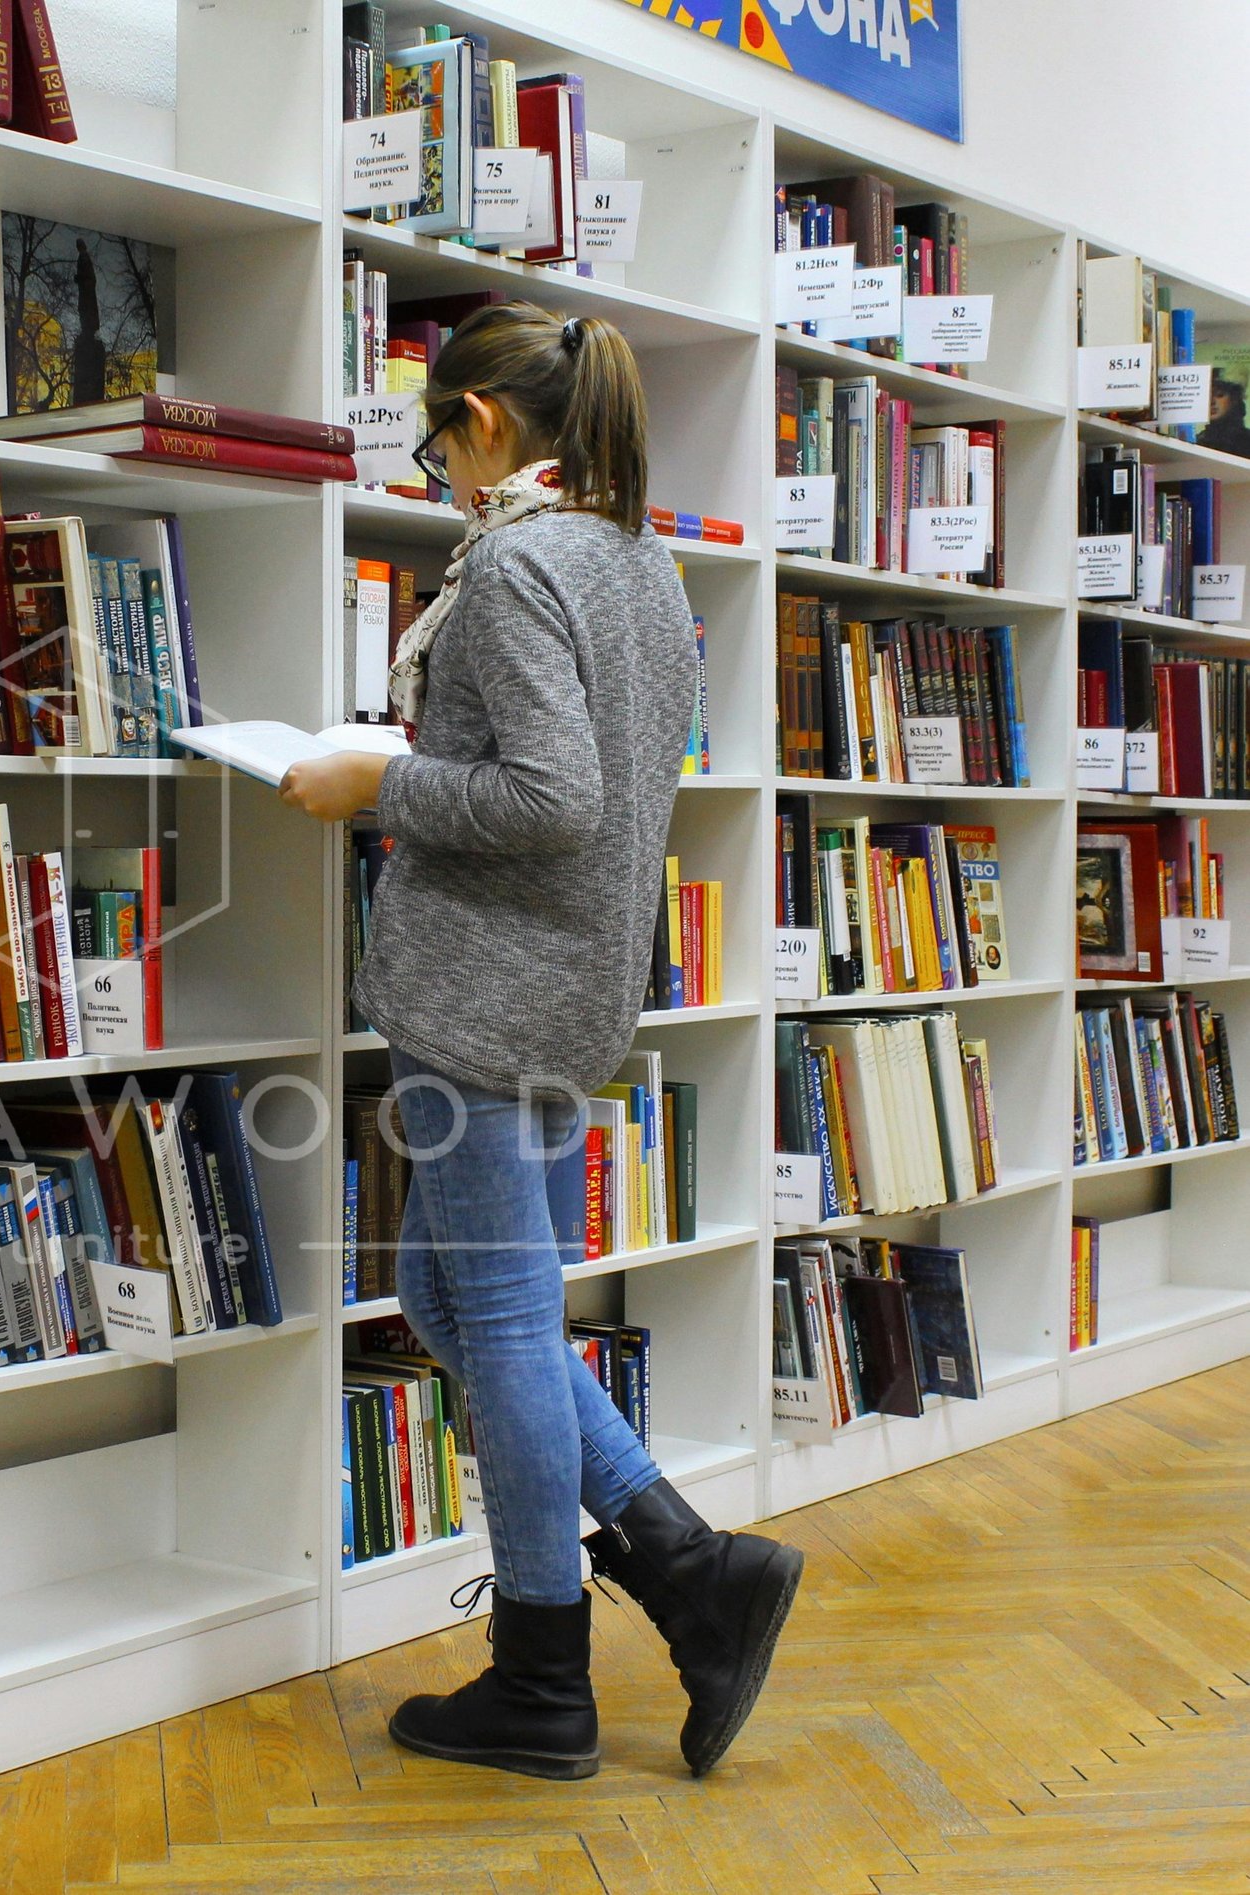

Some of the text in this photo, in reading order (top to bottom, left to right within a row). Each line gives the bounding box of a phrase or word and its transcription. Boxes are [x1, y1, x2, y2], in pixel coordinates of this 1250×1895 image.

[43, 73, 62, 90] 13
[48, 102, 69, 115] Т-Ц
[370, 132, 385, 147] 74
[486, 162, 503, 178] 75
[595, 195, 611, 210] 81
[576, 215, 627, 225] Языкознание
[586, 238, 612, 248] языке)
[795, 258, 838, 270] 81.2Нем
[798, 282, 835, 292] Немецкий
[952, 307, 966, 318] 82
[1109, 358, 1141, 370] 85.14
[161, 403, 217, 428] МОСКВА
[348, 408, 403, 427] 81.2Рус
[161, 435, 216, 458] МОСКВА
[790, 488, 806, 501] 83
[930, 517, 978, 529] 83.3(2Рос)
[932, 534, 973, 542] Литература
[940, 543, 964, 551] России
[1079, 545, 1121, 555] 85.143(3)
[1200, 574, 1230, 585] 85.37
[154, 613, 173, 690] ВЕСЬ МИР
[910, 727, 943, 737] 83.3(3)
[1085, 739, 1099, 749] 86
[1193, 929, 1206, 939] 92
[54, 911, 79, 1045] ЭКОНОМИКА БИЗНЕС
[95, 976, 111, 993] 66
[88, 1002, 120, 1011] Политика.
[83, 1014, 127, 1023] Политическая
[813, 1067, 839, 1210] ИСКУССТВО ВЕКА
[777, 1165, 792, 1178] 85
[118, 1282, 135, 1299] 68
[12, 1278, 37, 1342] ПРАВОСУДИЕ
[107, 1306, 134, 1318] Военное
[107, 1318, 156, 1334] Военная наука
[774, 1390, 808, 1403] 85.11
